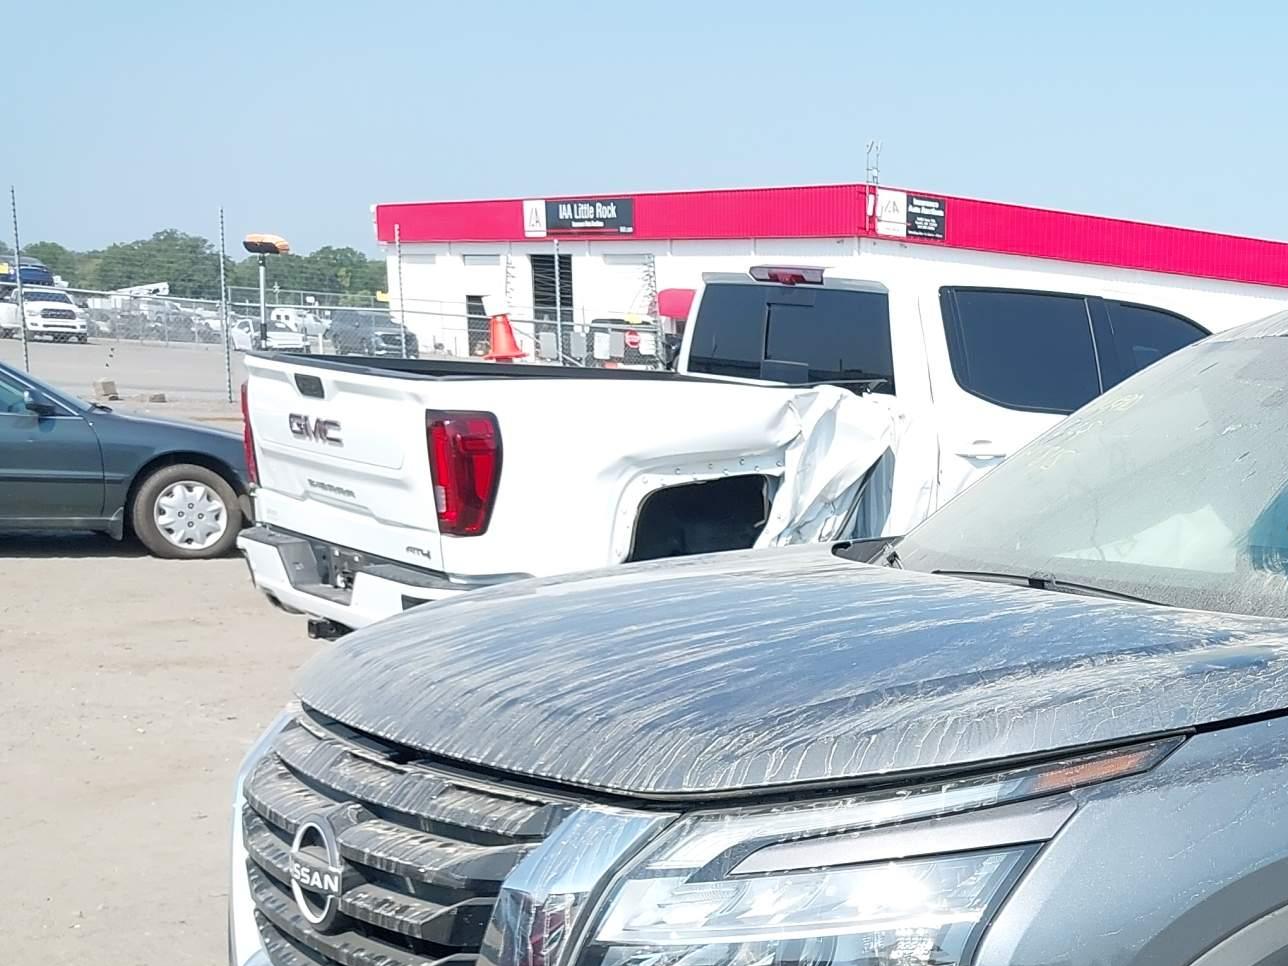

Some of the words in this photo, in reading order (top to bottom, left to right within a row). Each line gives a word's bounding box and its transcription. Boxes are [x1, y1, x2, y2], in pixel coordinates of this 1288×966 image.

[558, 203, 573, 219] IAA
[573, 203, 594, 219] Little
[595, 202, 617, 218] Rock
[289, 413, 343, 447] GMC
[406, 546, 432, 561] AT4
